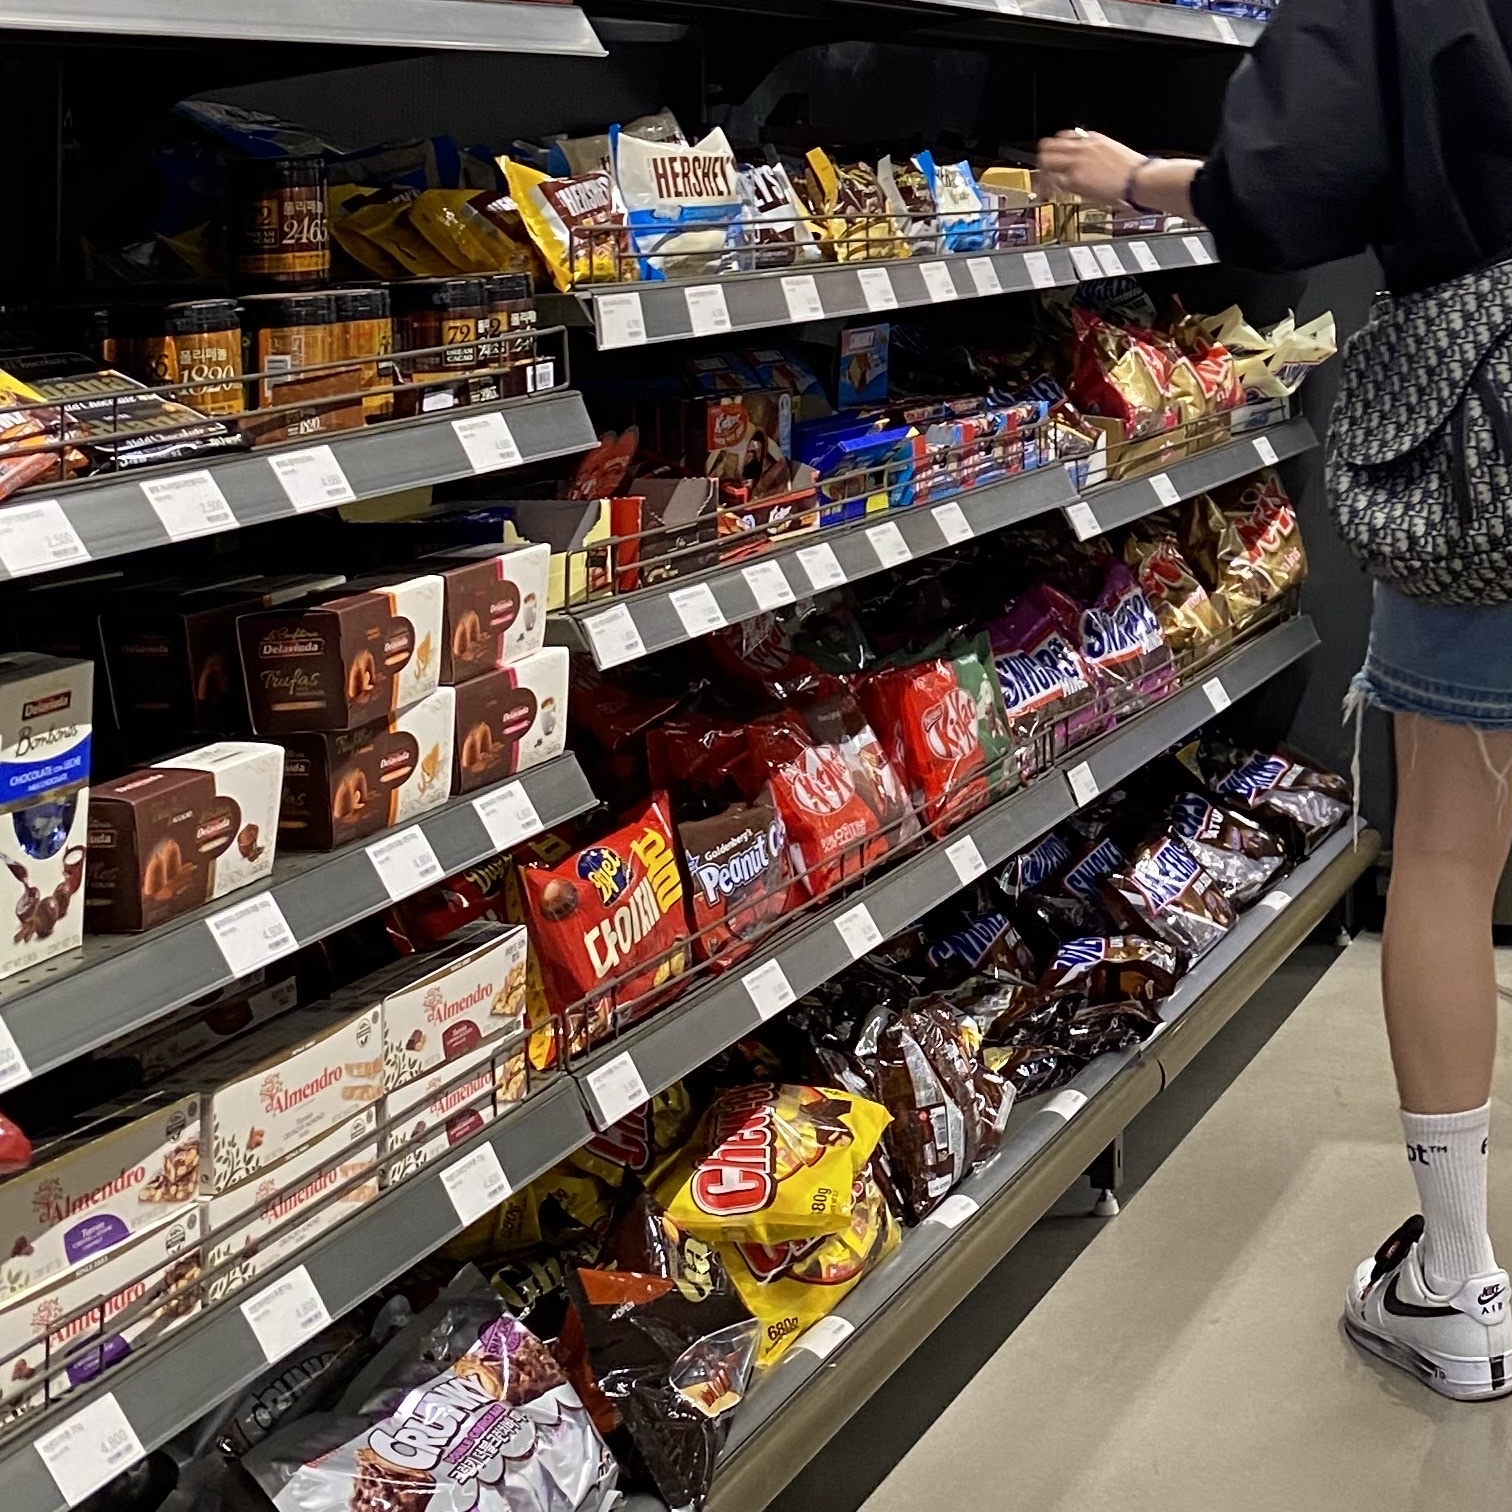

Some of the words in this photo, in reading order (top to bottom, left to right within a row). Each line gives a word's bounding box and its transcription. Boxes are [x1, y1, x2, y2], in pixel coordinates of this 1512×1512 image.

[282, 217, 329, 245] 2465
[447, 325, 471, 345] 72
[179, 347, 227, 365] 폴리페놀
[179, 363, 236, 397] 1820
[704, 828, 753, 861] Goldenberg's
[630, 827, 684, 914] 미니
[699, 838, 770, 907] Peanut
[583, 874, 661, 978] 다이제
[434, 982, 494, 1026] Almendro
[273, 1064, 343, 1116] Almendro
[52, 1165, 146, 1222] Almendro
[1482, 1283, 1501, 1297] NIKE
[1481, 1301, 1503, 1315] AIR
[767, 1316, 799, 1341] 680g
[368, 1372, 496, 1471] CRUNKY
